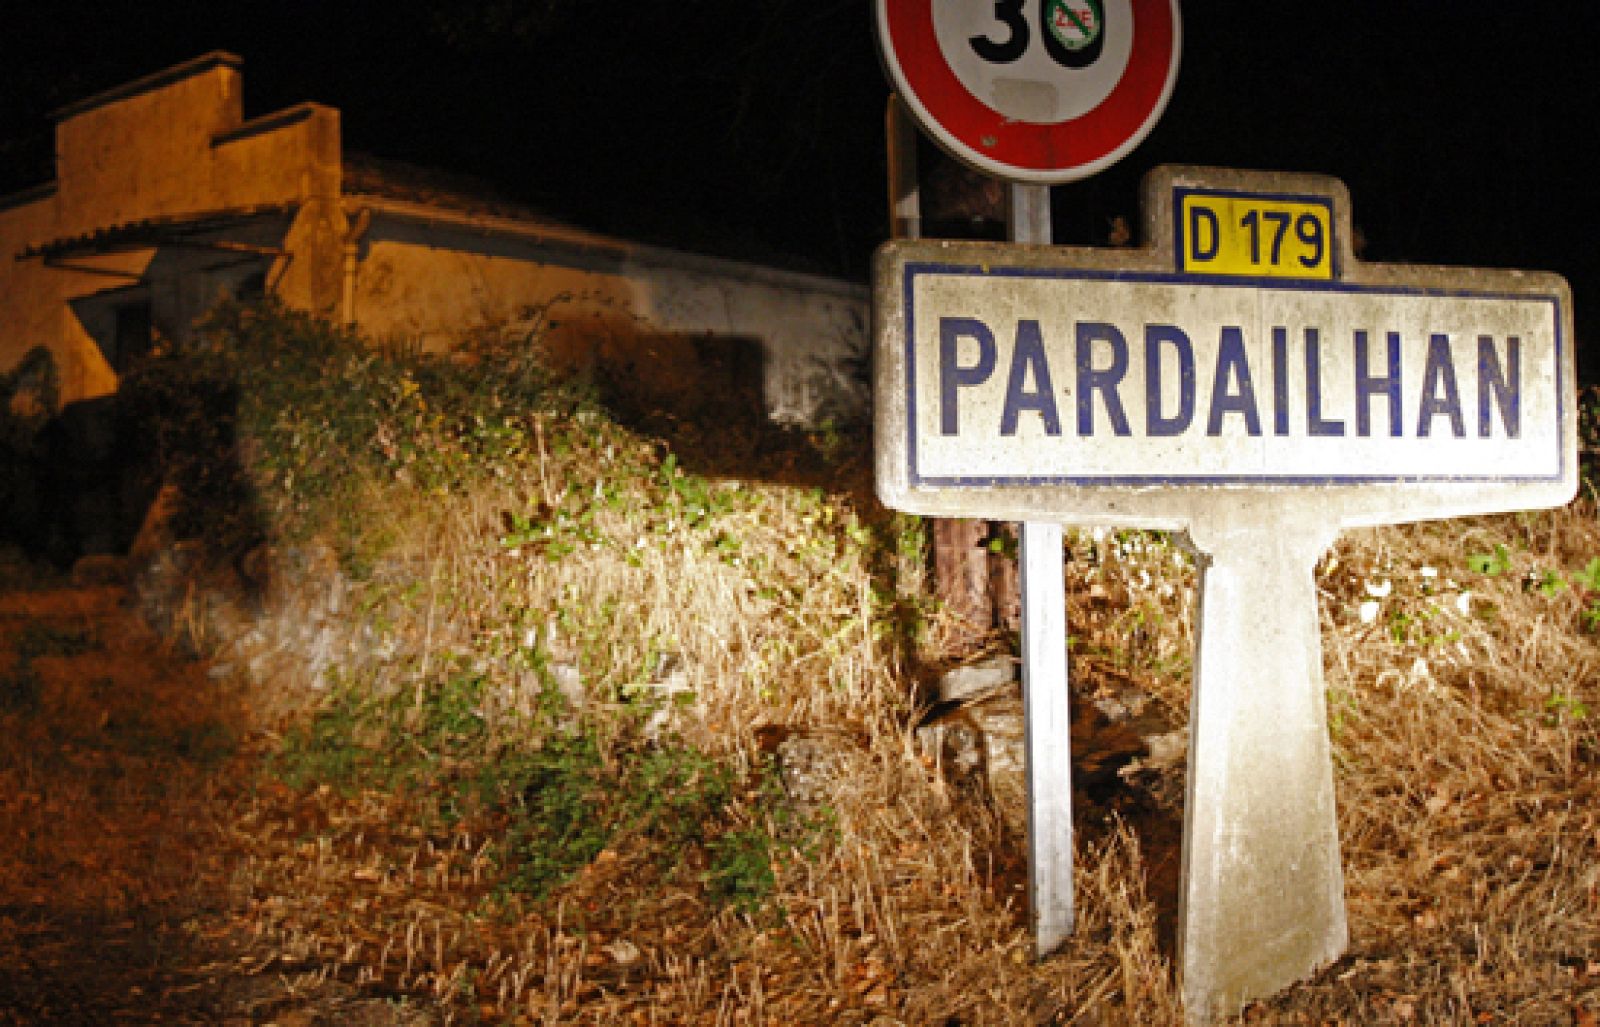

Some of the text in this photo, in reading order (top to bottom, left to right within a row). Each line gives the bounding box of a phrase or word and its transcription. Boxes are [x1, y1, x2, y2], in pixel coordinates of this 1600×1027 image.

[968, 0, 1104, 68] 30
[1190, 206, 1324, 268] D 179
[939, 316, 1521, 438] PARDAILHAN
